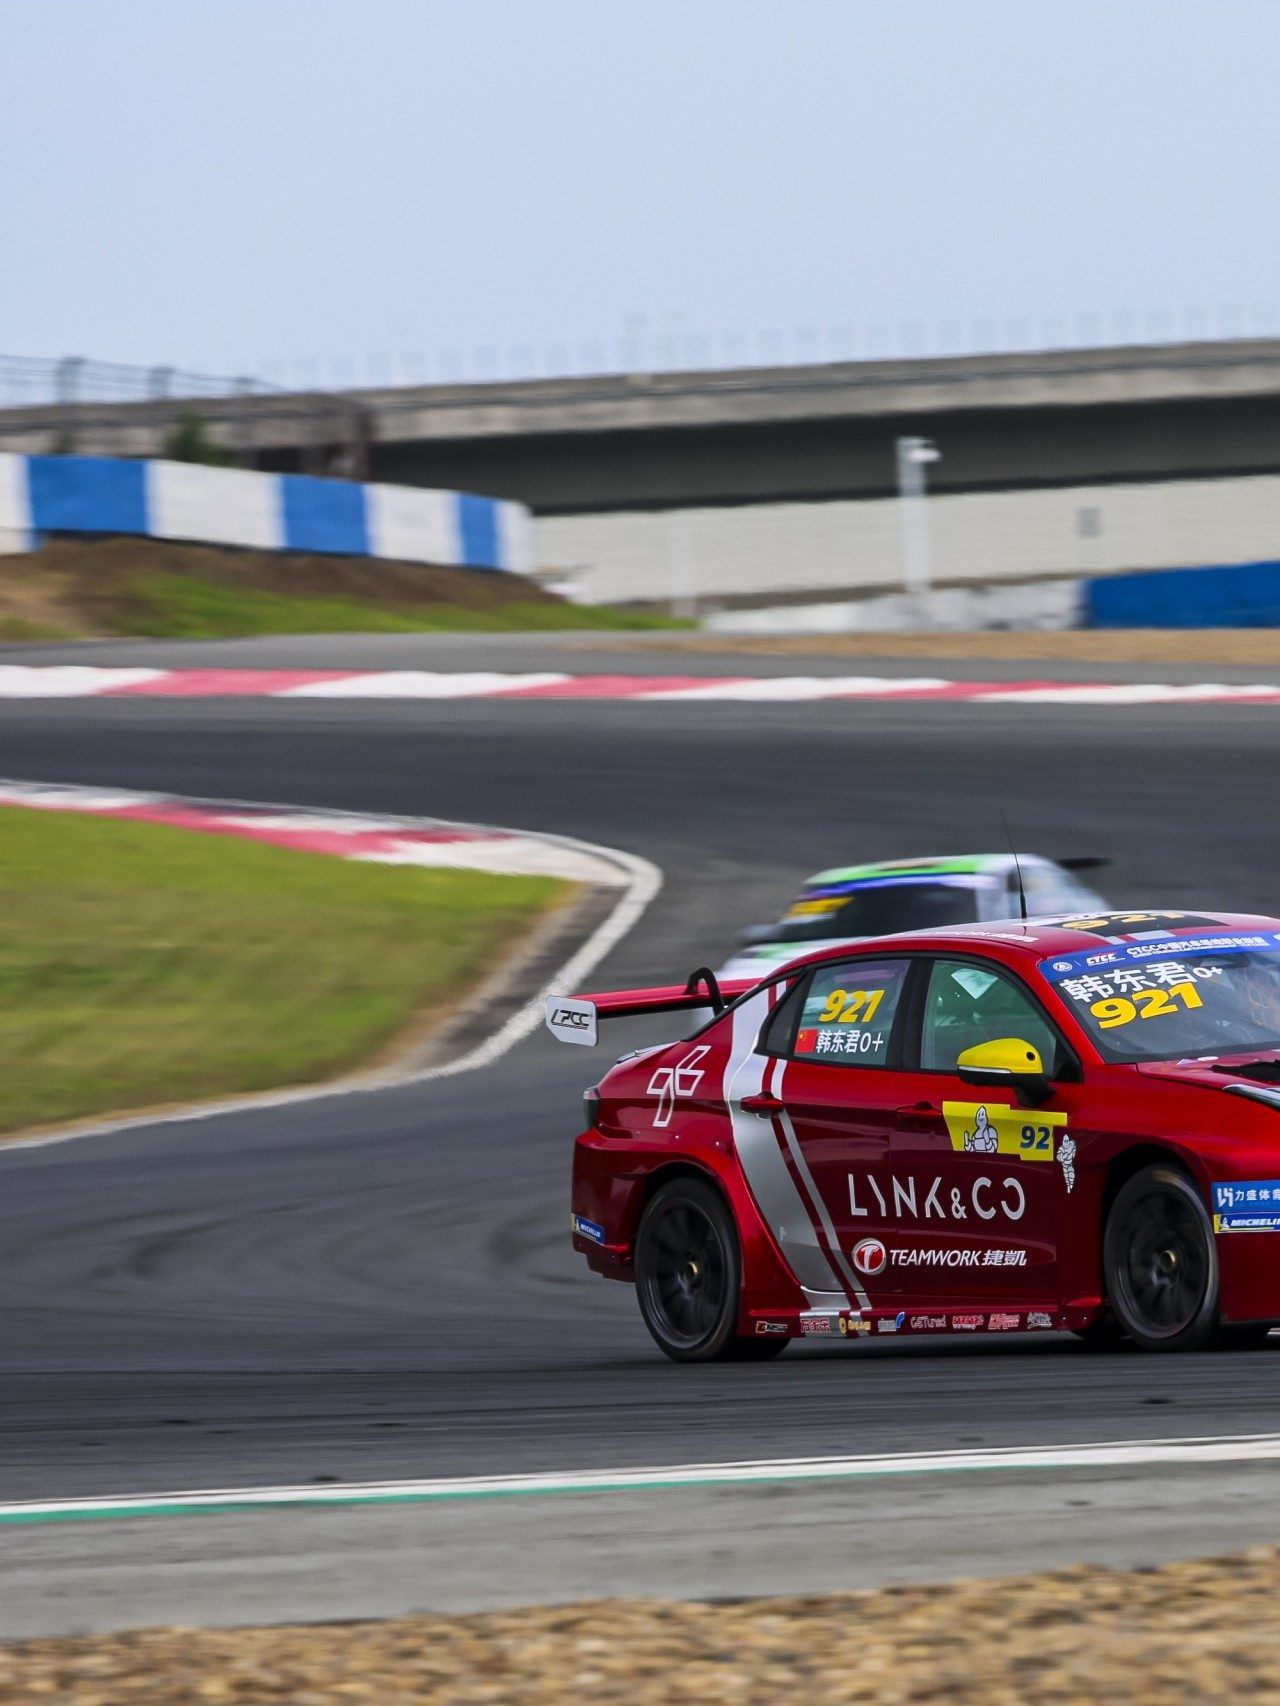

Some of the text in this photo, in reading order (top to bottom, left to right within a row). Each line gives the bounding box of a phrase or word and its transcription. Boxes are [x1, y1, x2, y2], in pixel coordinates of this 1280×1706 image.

[819, 989, 885, 1023] 921
[1090, 982, 1203, 1030] 921
[890, 1250, 982, 1266] TEAMWORK
